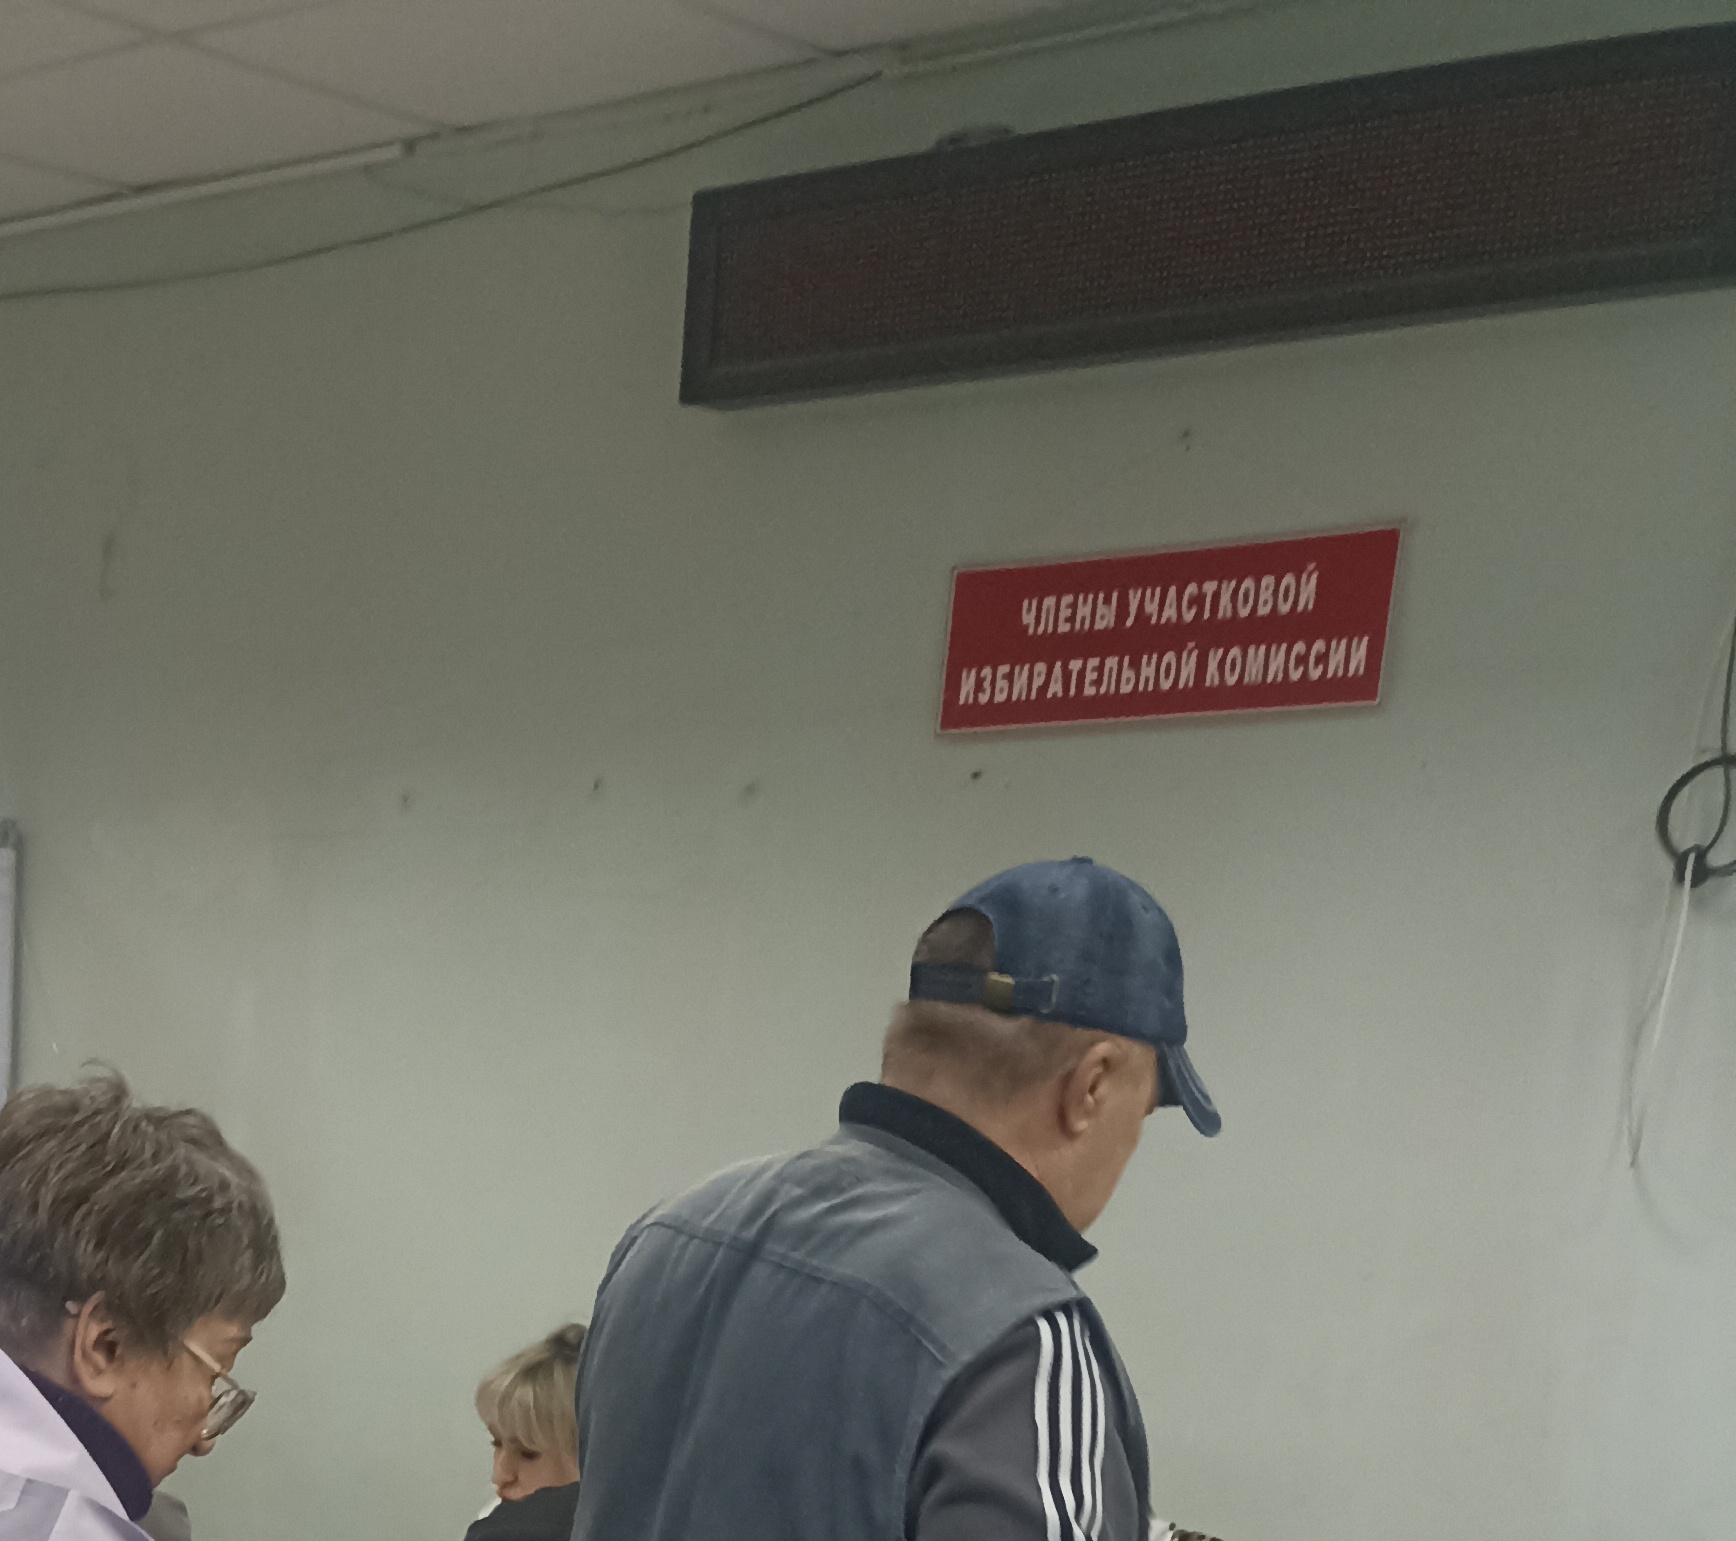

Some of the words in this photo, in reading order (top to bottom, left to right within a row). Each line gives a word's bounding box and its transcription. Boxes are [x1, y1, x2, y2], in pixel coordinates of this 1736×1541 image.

[1020, 588, 1118, 637] ЧЛЕНЫ
[1124, 562, 1320, 628] УЧАСТКОВОЙ
[958, 641, 1198, 705] ИЗБИРАТЕЛЬНОЙ
[1204, 635, 1370, 687] КОМИССИИ
